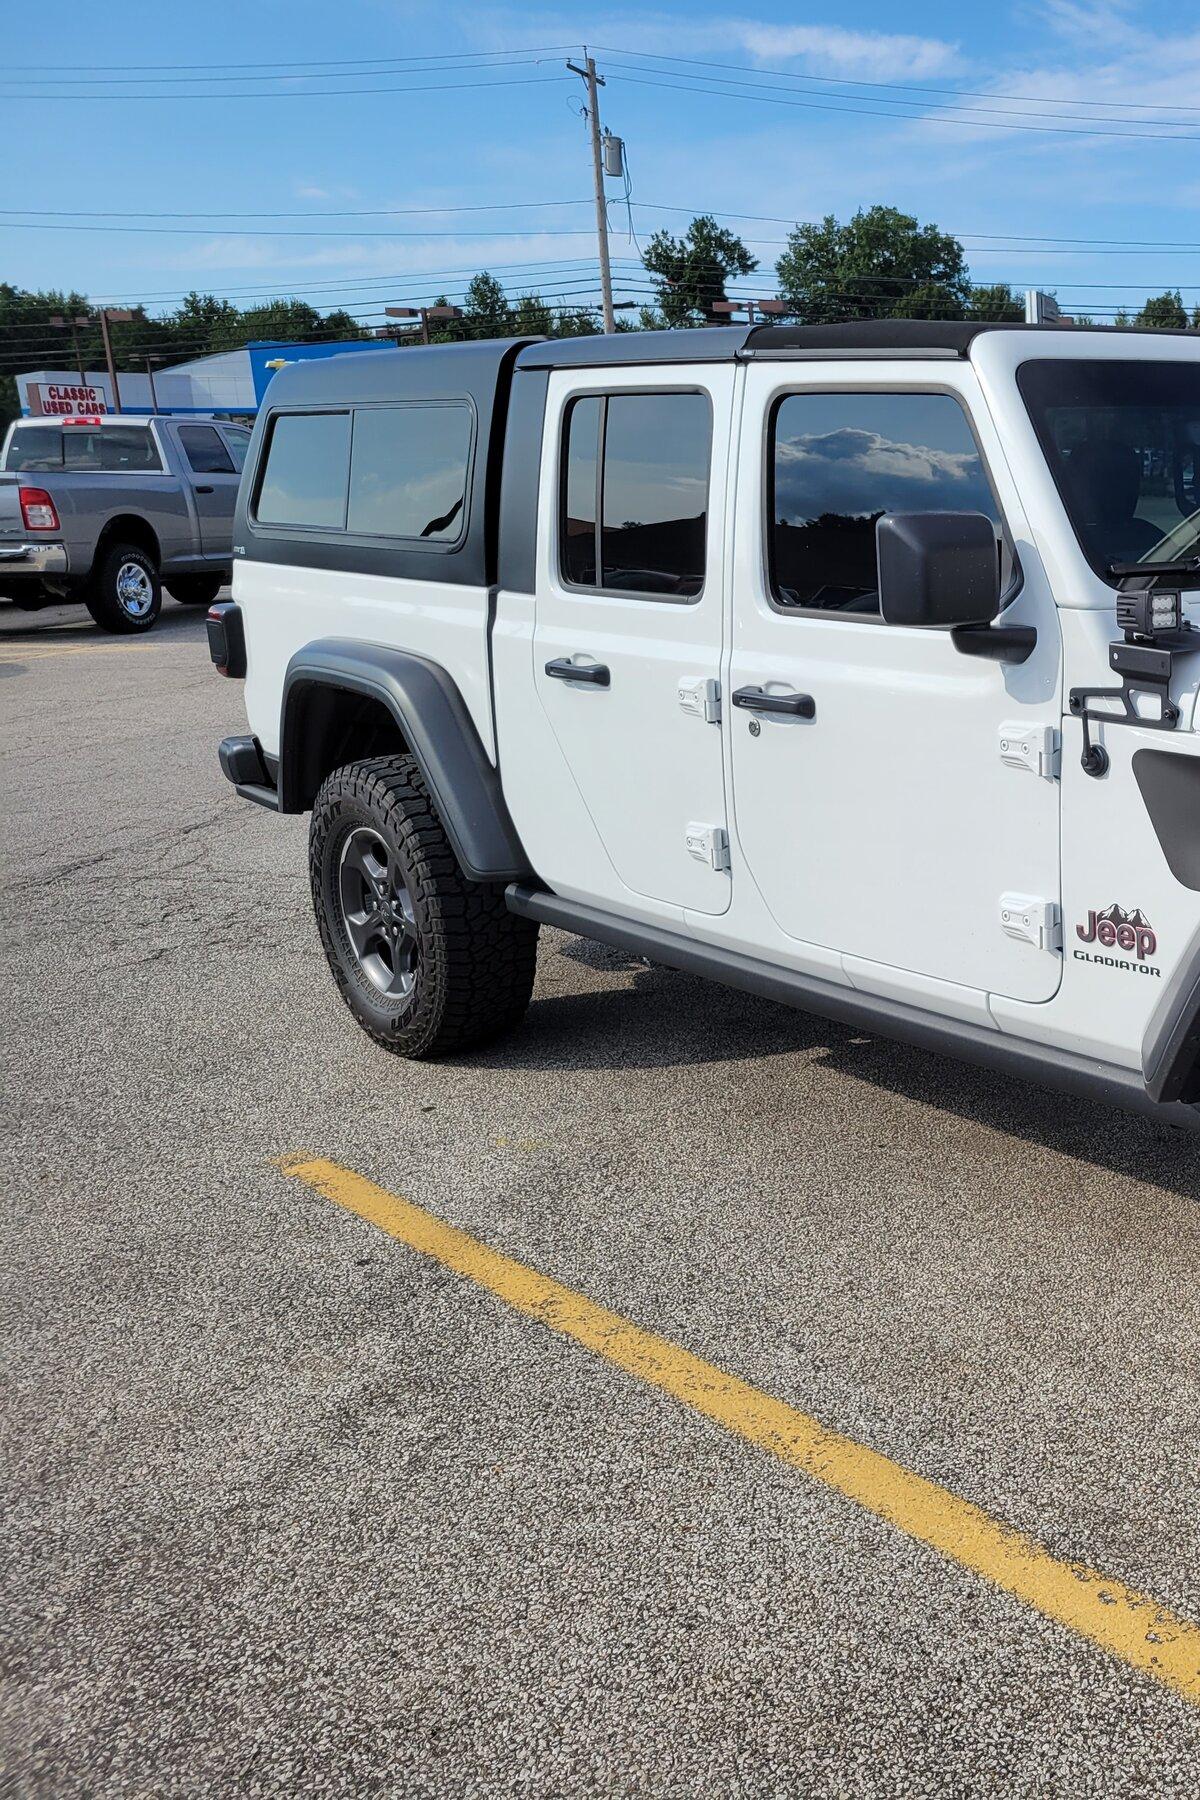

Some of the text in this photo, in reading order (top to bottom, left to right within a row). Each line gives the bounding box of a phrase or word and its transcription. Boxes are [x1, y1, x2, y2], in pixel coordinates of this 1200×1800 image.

[48, 385, 96, 401] CLASSIC
[43, 400, 107, 416] USED CARS
[1076, 909, 1157, 961] Jeep
[1073, 950, 1162, 978] GLADIATOR
